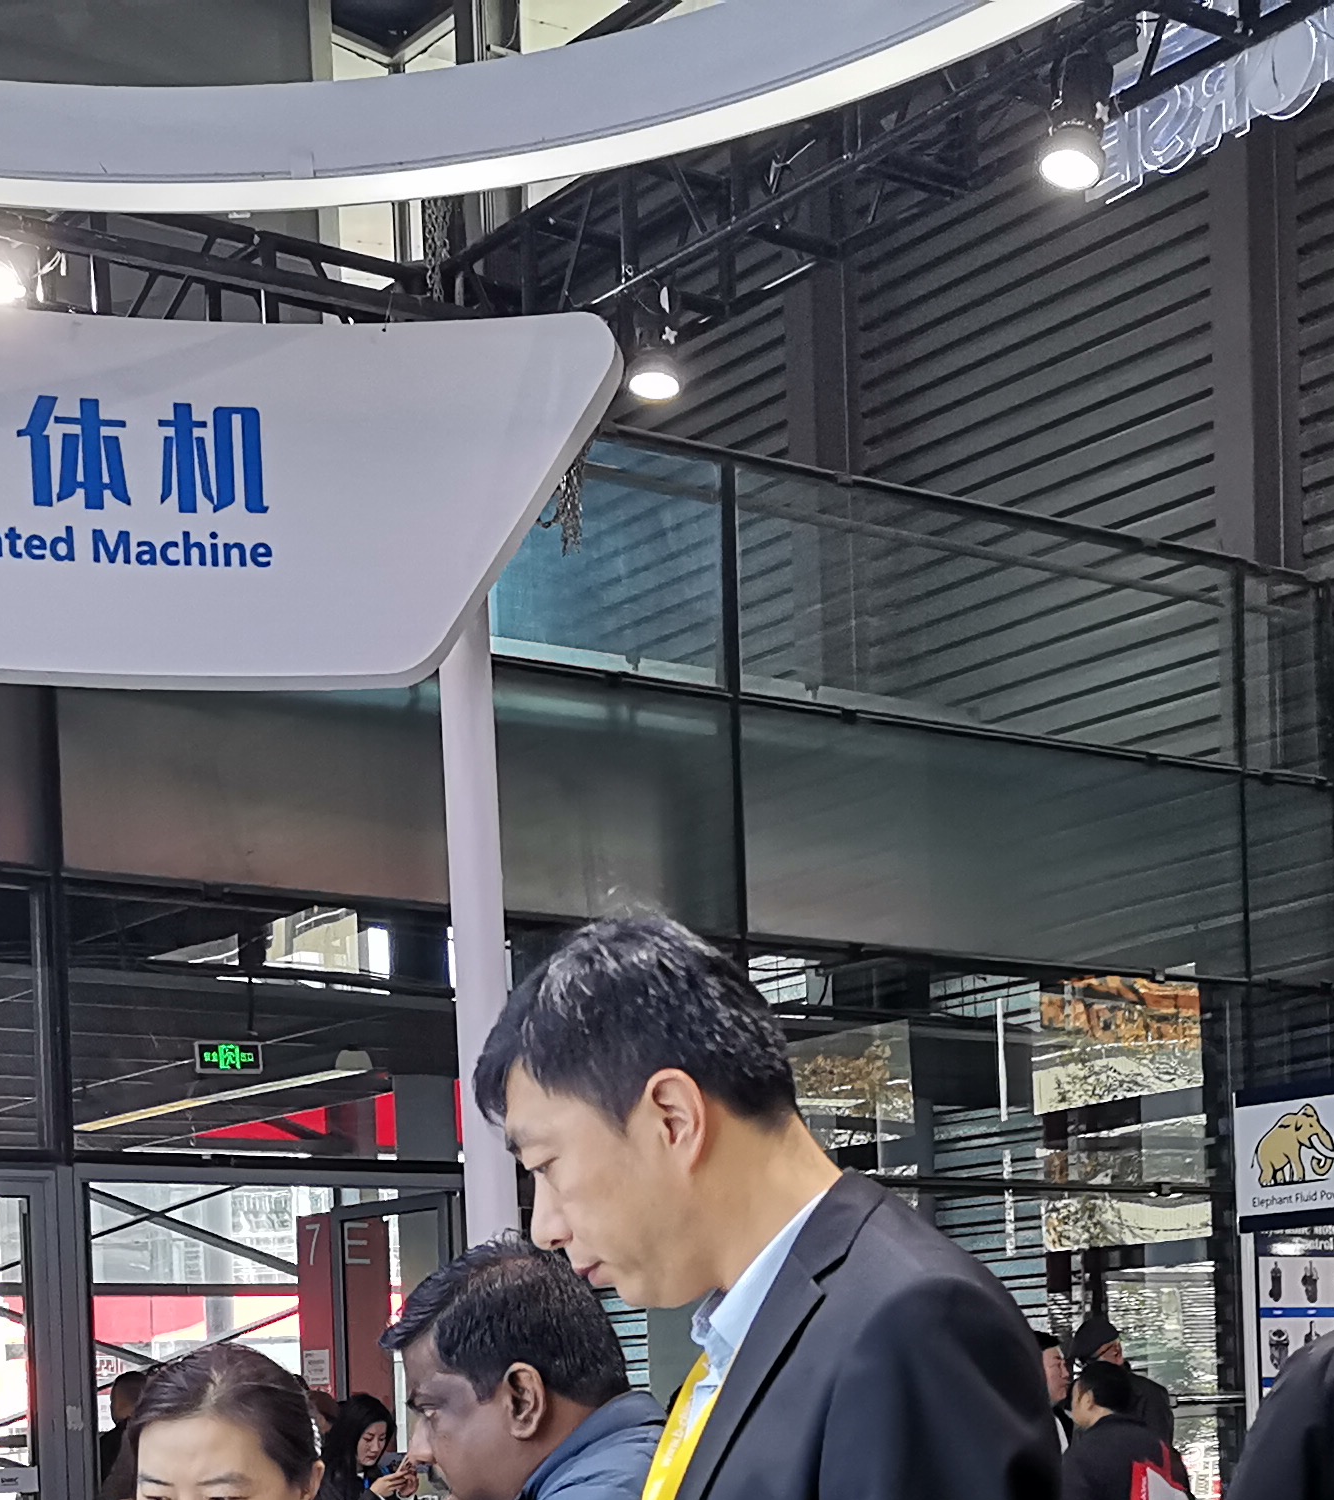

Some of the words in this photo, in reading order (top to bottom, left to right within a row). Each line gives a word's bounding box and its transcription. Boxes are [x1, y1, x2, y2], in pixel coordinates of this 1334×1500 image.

[91, 529, 274, 568] Machine
[1252, 1194, 1294, 1208] Elephant
[1295, 1191, 1317, 1204] Fluid
